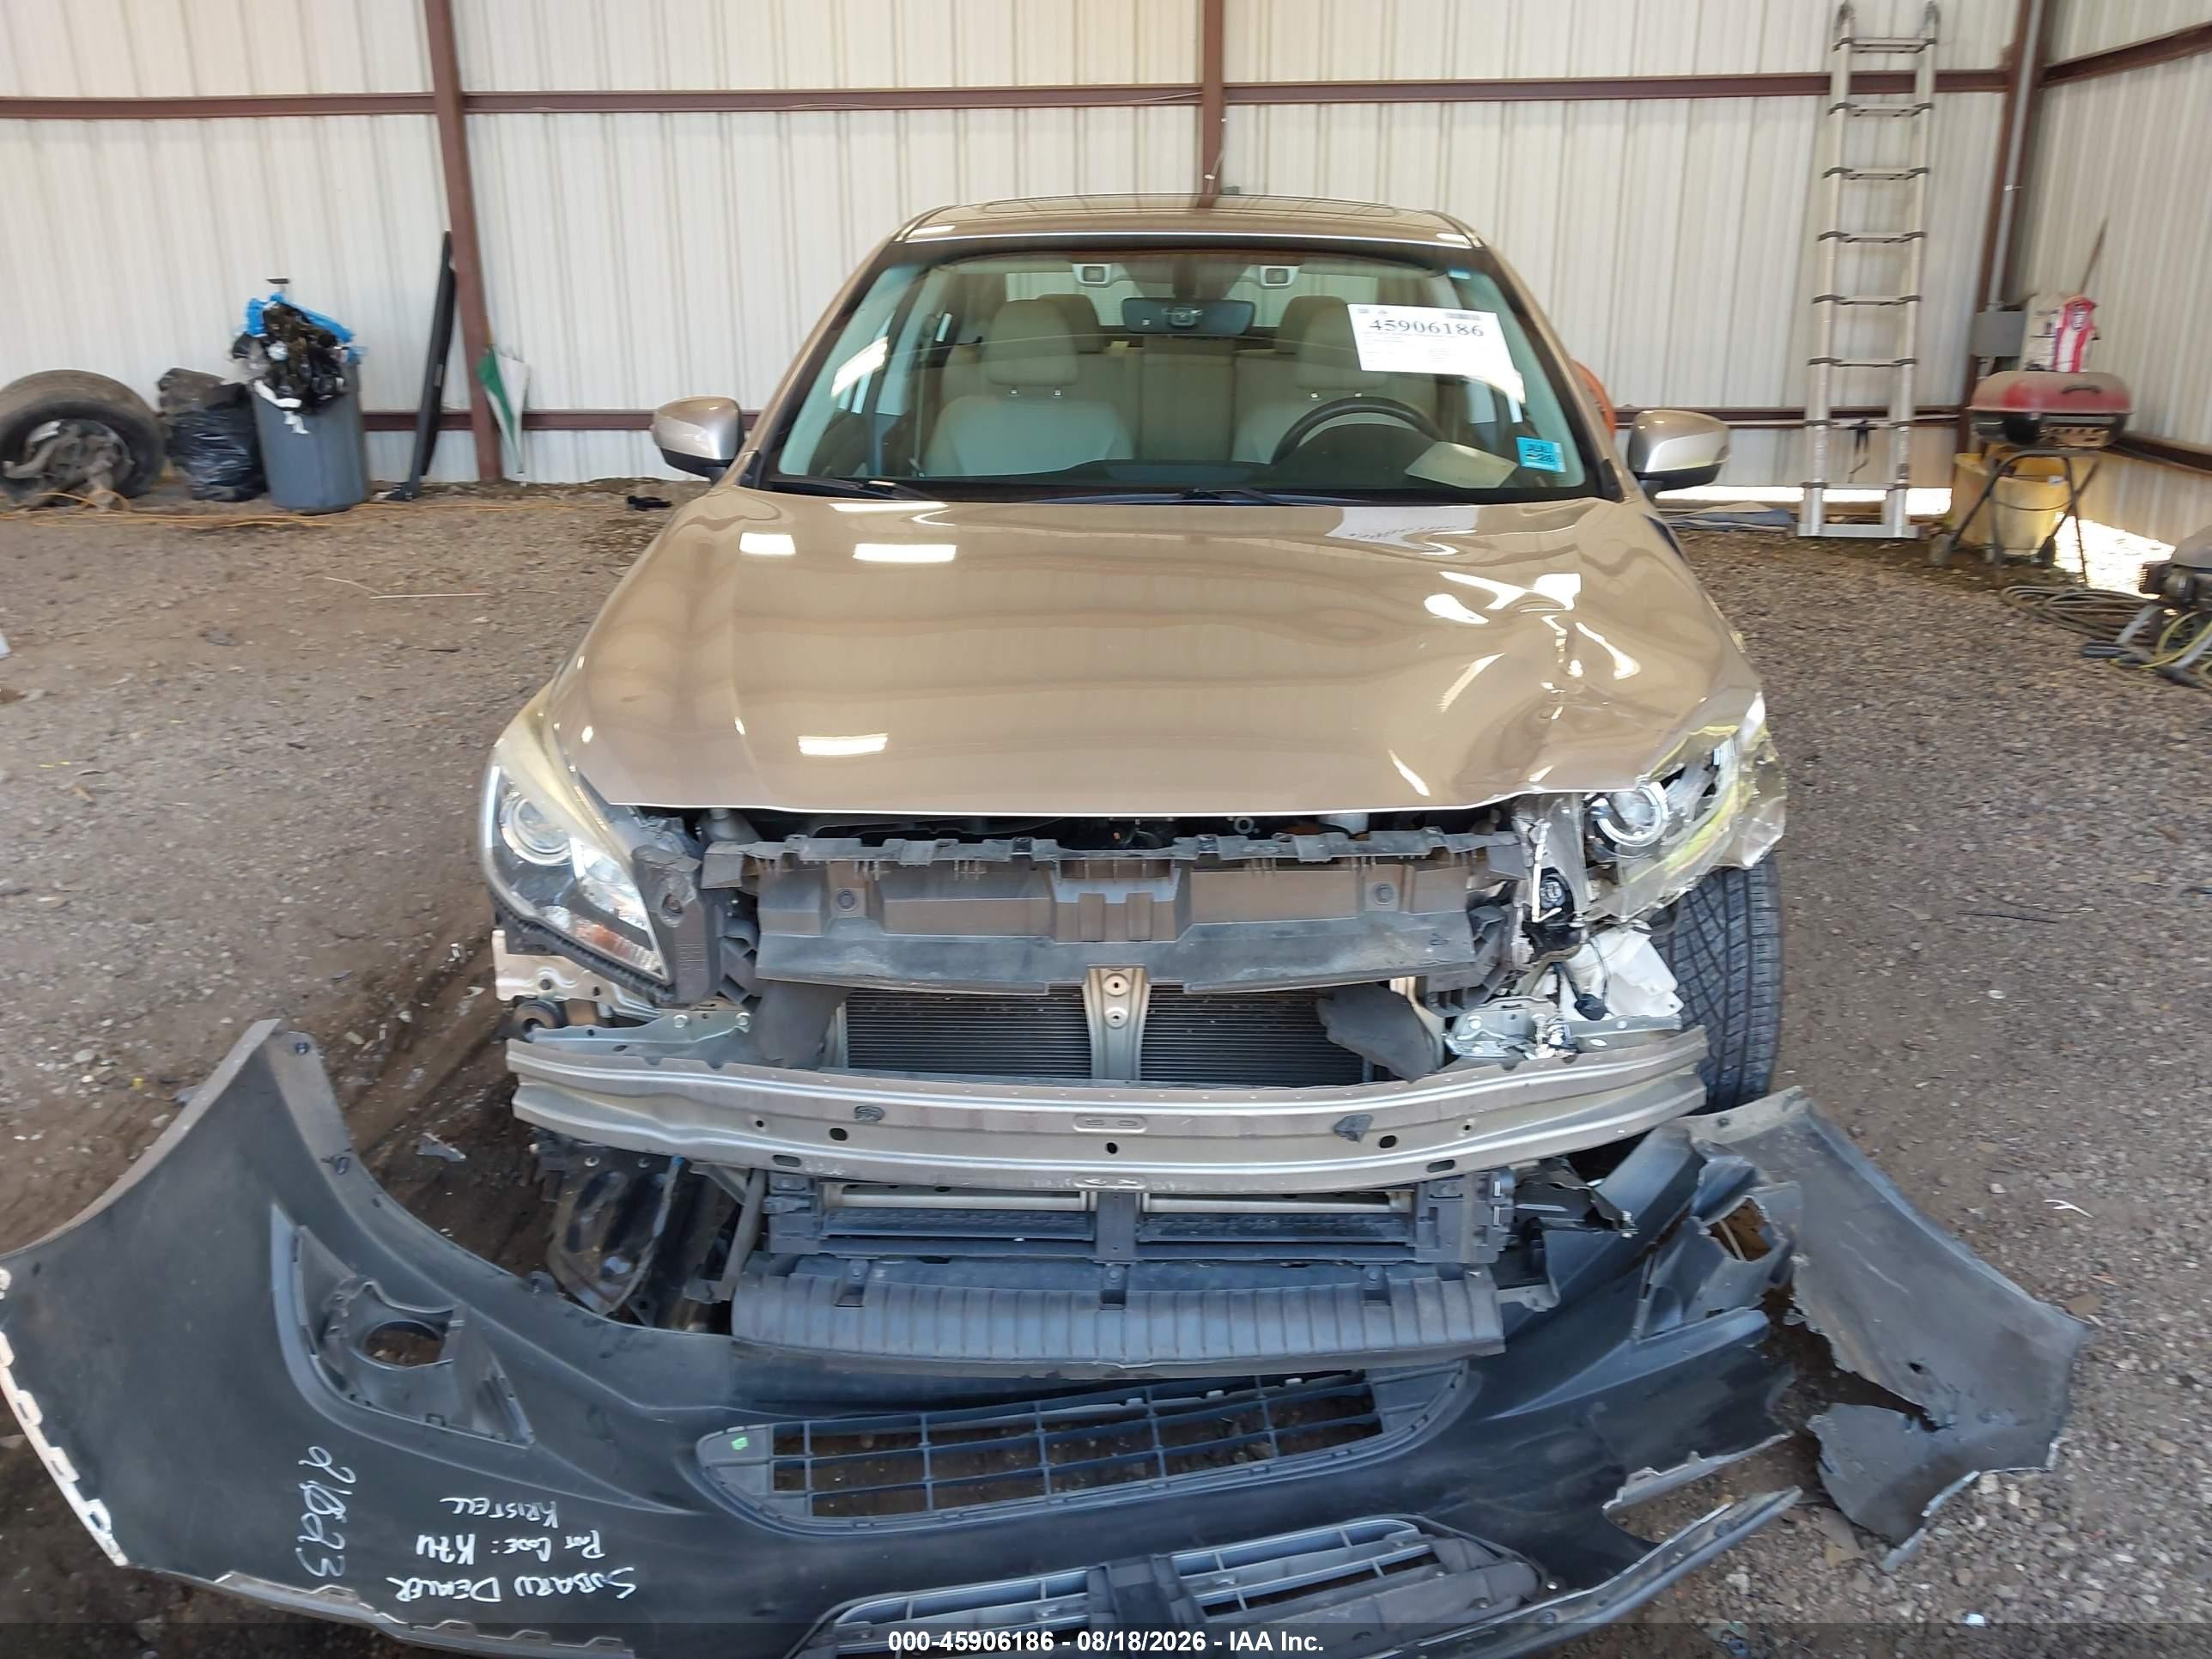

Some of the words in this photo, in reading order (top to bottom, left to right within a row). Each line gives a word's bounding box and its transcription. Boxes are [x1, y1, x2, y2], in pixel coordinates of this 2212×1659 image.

[1368, 319, 1485, 337] 45906186
[440, 1497, 559, 1528] KRISTELL
[386, 1576, 501, 1602] DEALER
[514, 1567, 636, 1599] SUBARU
